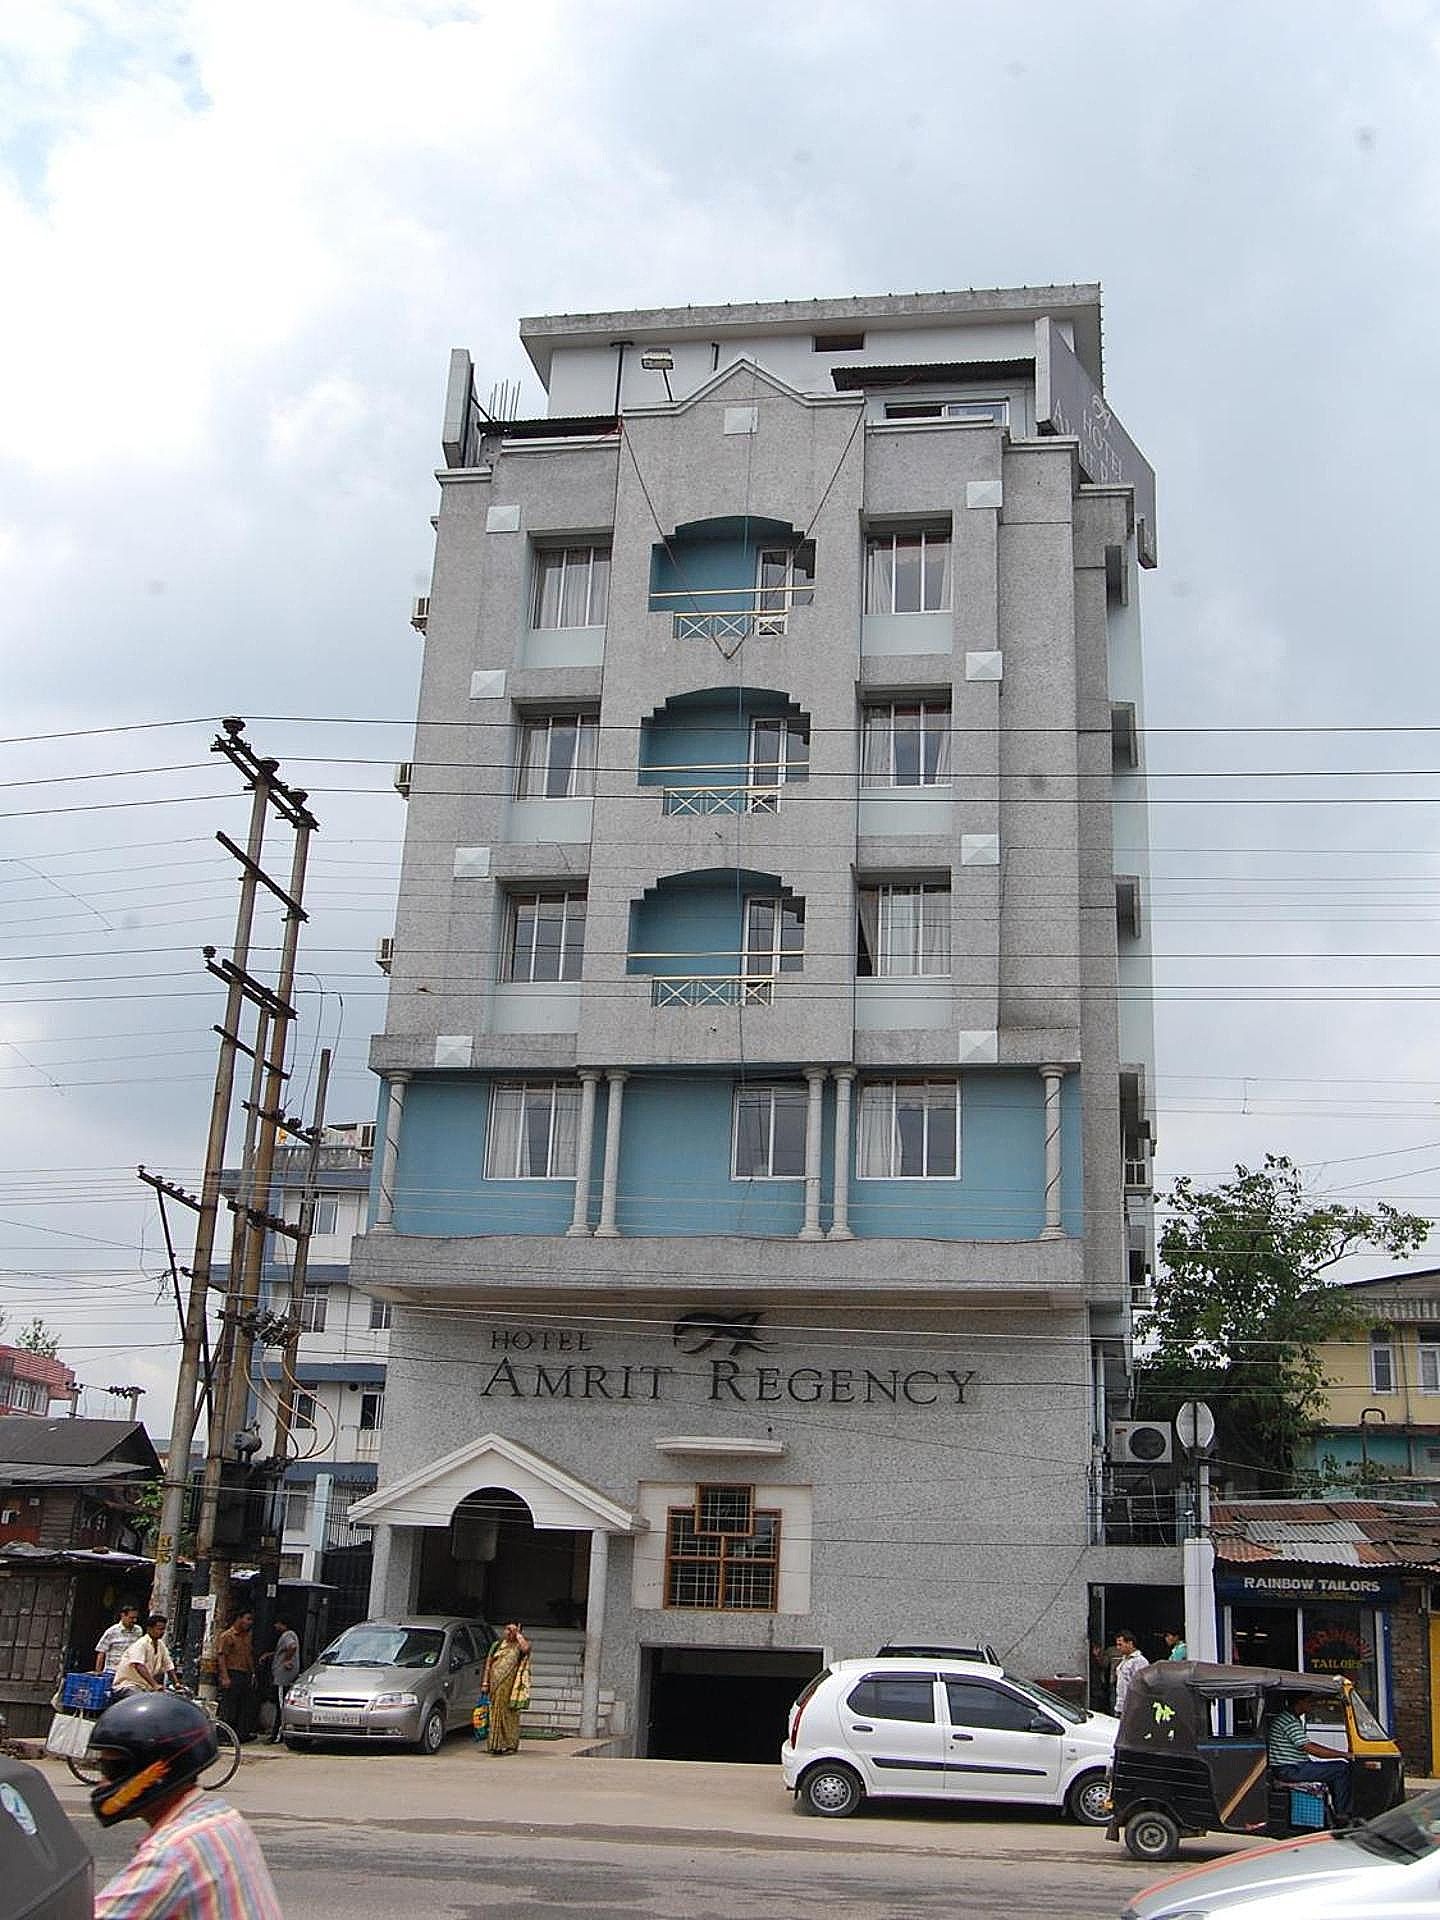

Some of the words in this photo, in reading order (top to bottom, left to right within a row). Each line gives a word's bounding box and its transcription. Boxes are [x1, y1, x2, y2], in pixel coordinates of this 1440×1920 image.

[490, 1330, 593, 1351] HOTEL
[480, 1357, 675, 1400] AMRIT
[709, 1358, 977, 1405] REGENCY
[1244, 1577, 1314, 1591] RAINBOW
[1319, 1579, 1381, 1592] TAILORS
